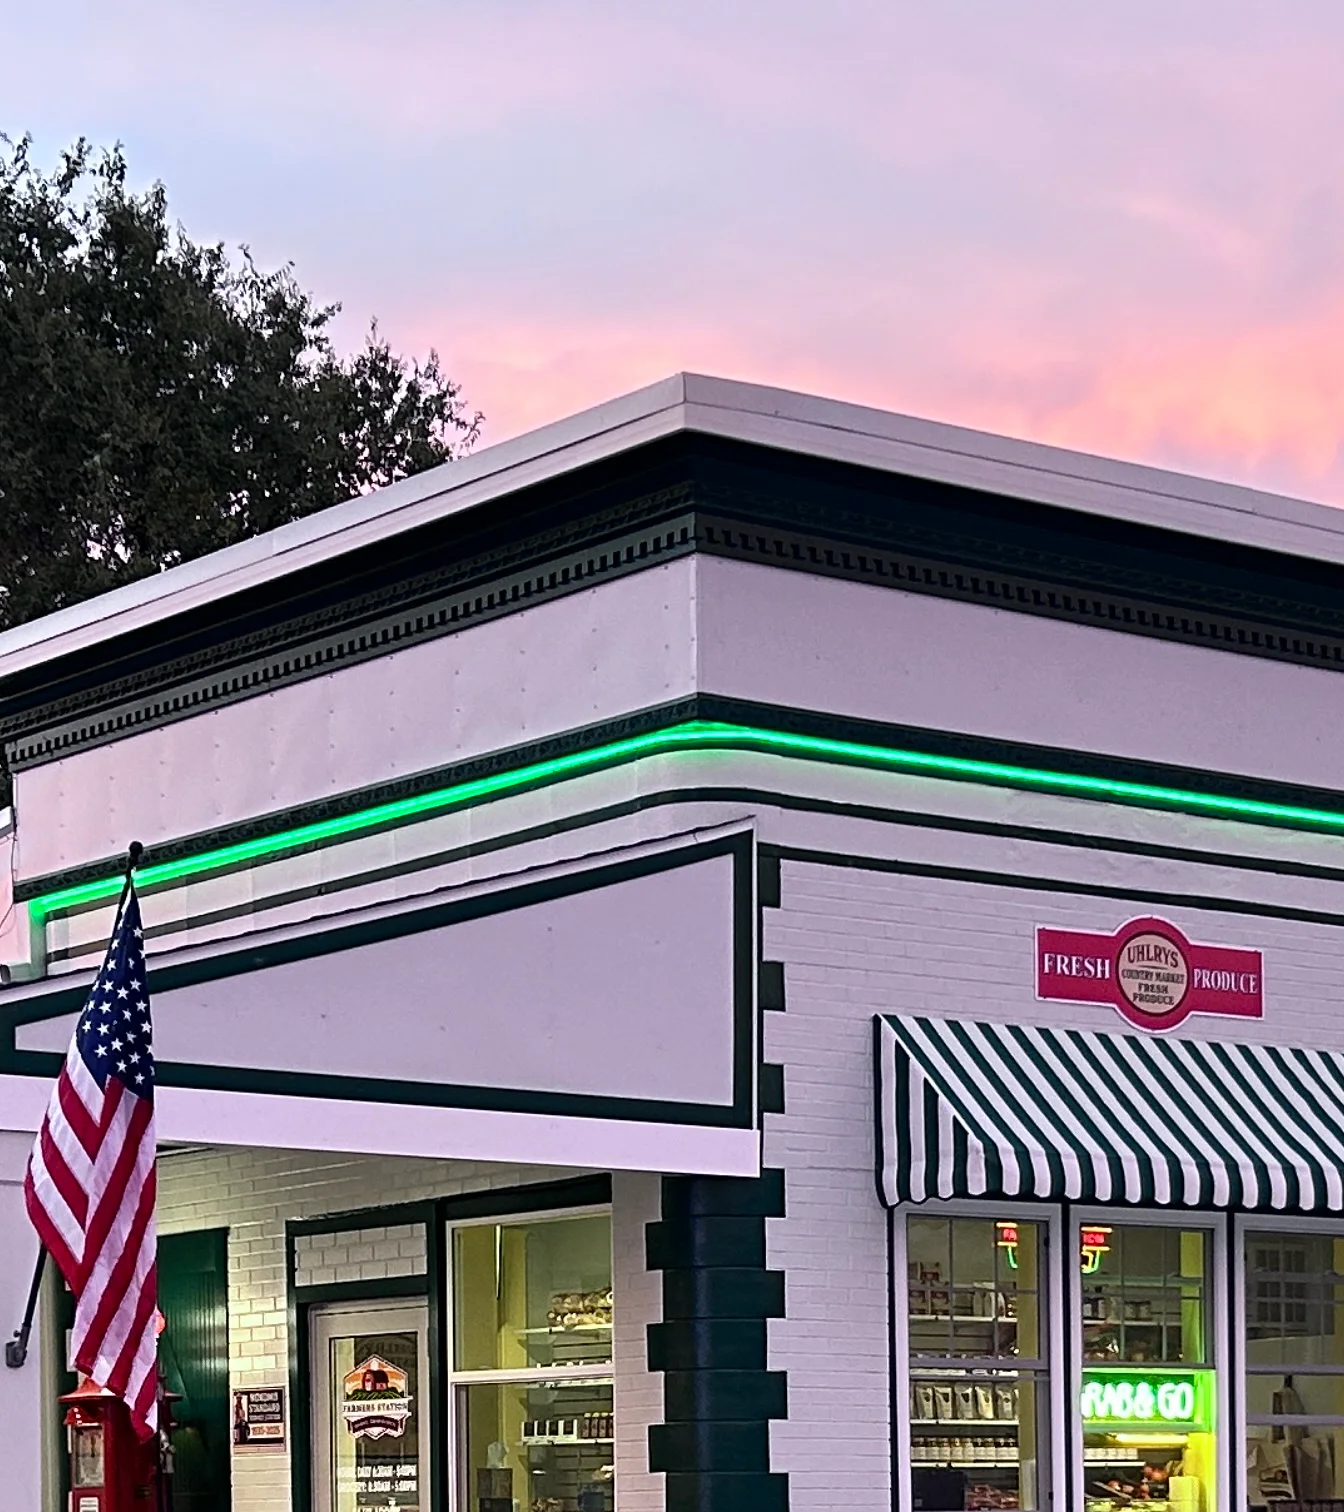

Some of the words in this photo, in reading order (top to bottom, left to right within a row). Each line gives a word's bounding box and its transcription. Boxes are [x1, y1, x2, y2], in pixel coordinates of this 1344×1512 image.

[1127, 944, 1179, 968] UHLRYS
[1043, 953, 1110, 979] FRESH
[1193, 968, 1258, 994] PRODUCE
[1155, 971, 1185, 984] MARKET
[1138, 982, 1169, 993] FRESH
[1133, 992, 1175, 1005] PRODUCE
[1157, 1382, 1194, 1419] GO
[343, 1403, 375, 1413] FARMERS
